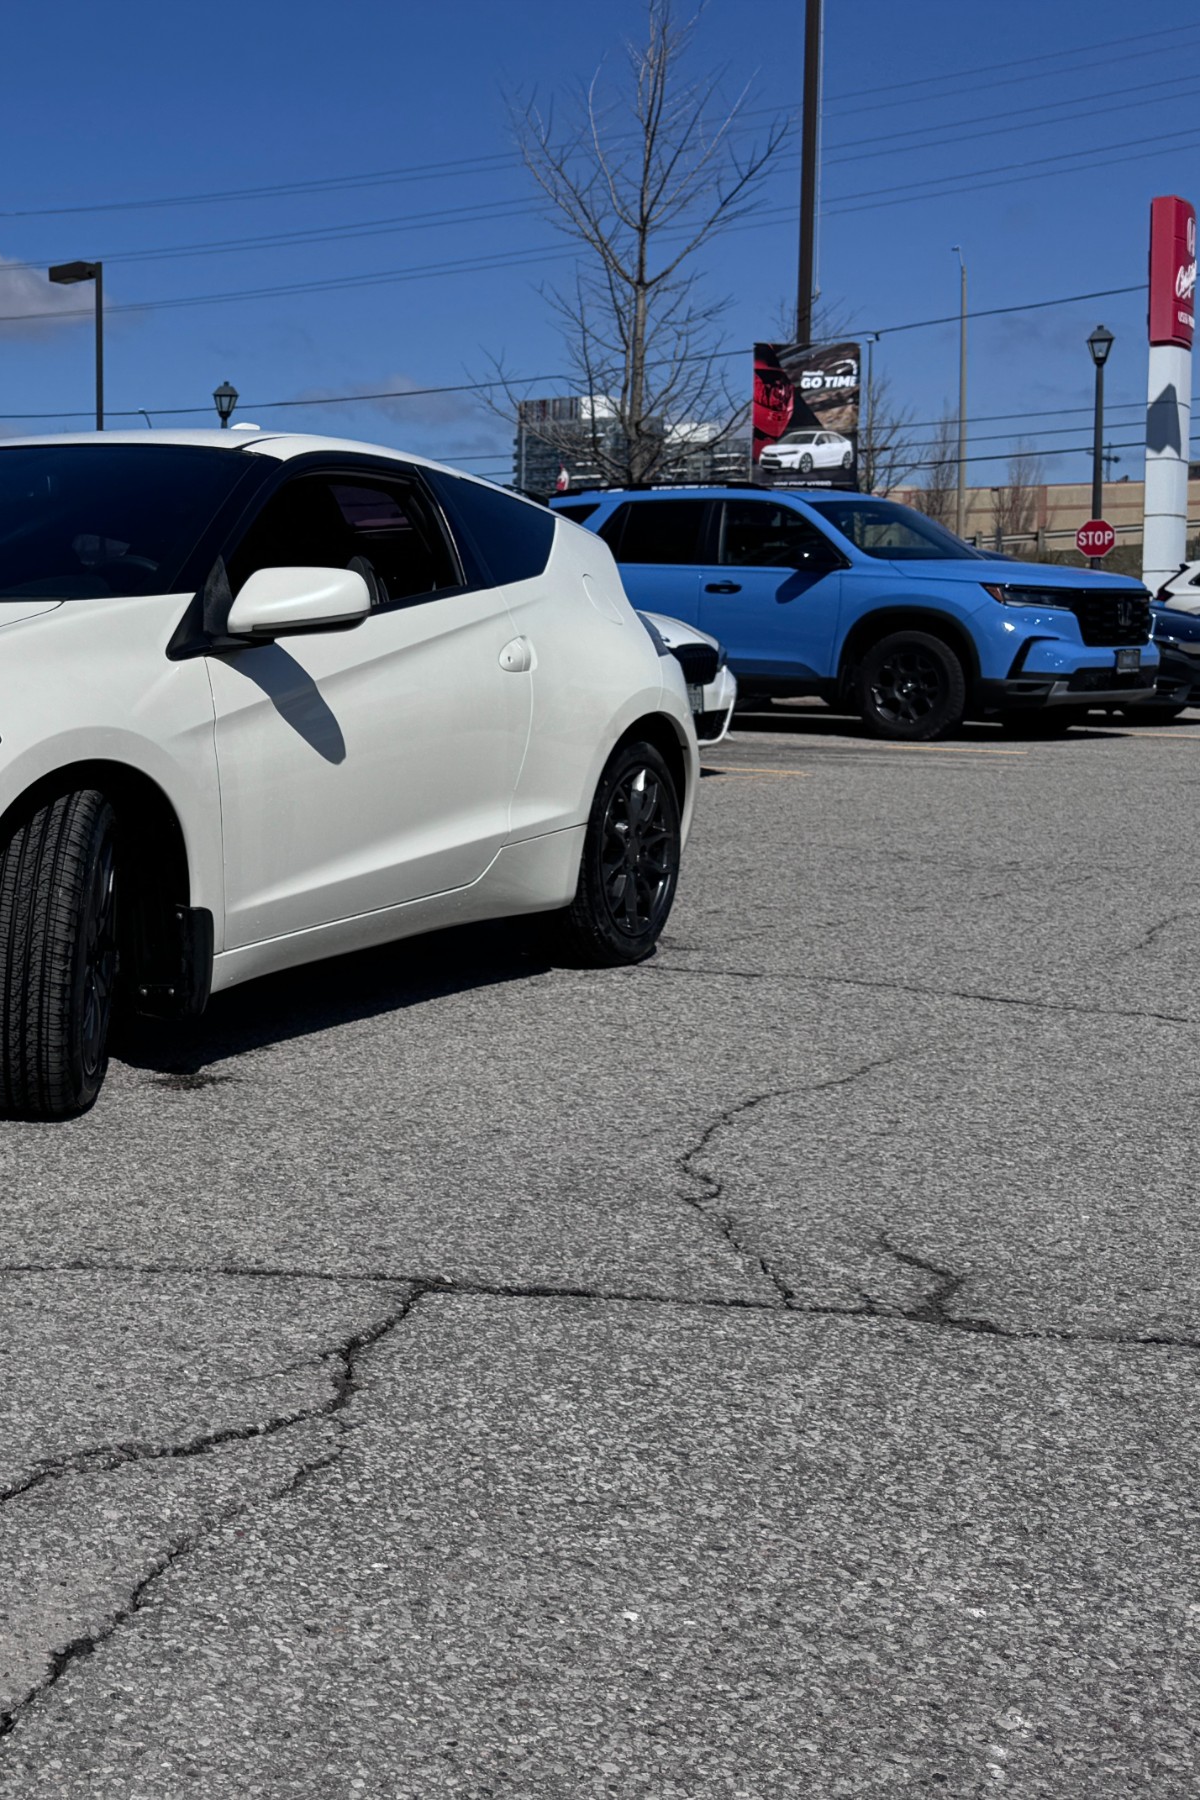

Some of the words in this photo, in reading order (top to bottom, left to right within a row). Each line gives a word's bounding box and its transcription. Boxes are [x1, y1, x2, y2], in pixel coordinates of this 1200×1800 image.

[800, 377, 822, 389] GO
[824, 376, 857, 388] TIME
[1078, 530, 1114, 546] STOP
